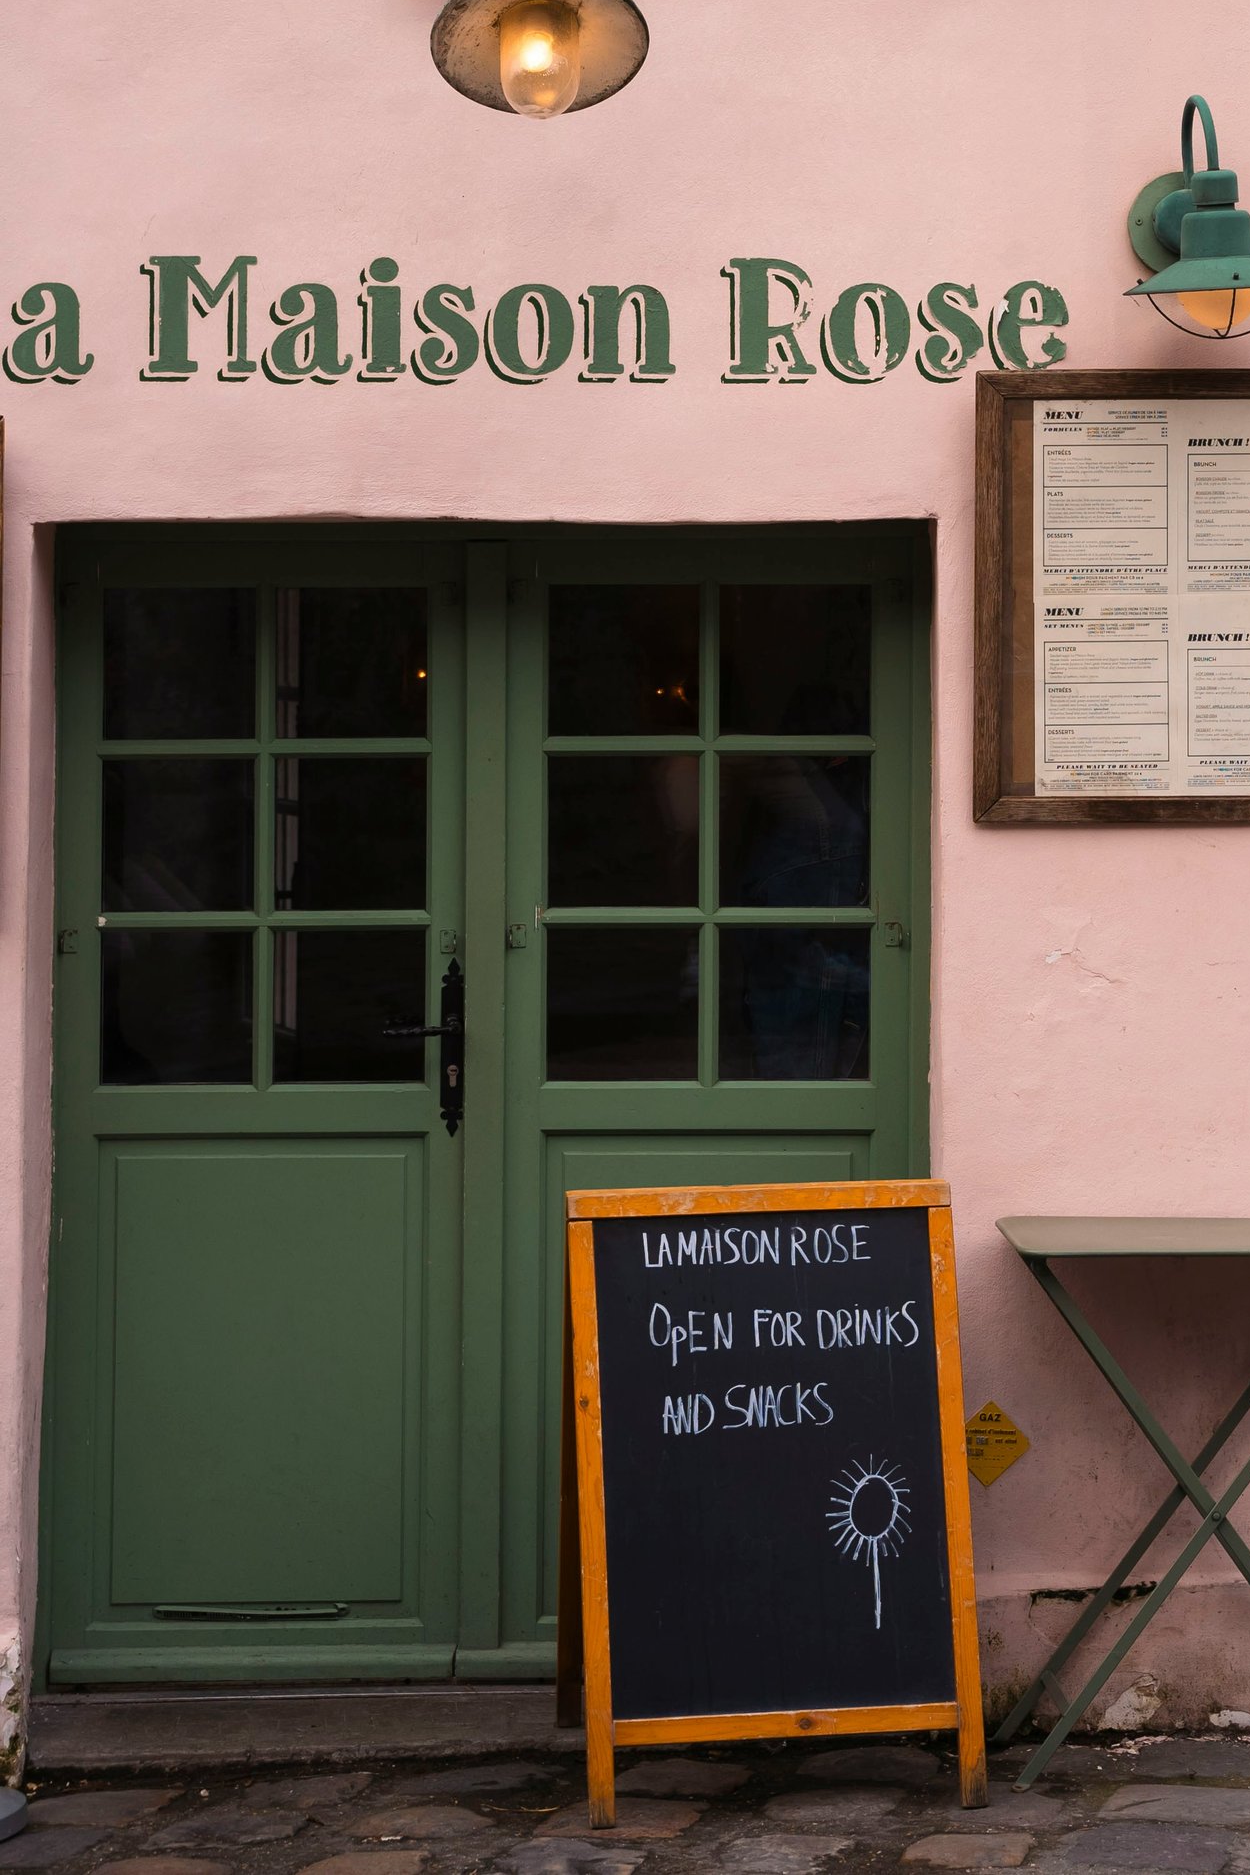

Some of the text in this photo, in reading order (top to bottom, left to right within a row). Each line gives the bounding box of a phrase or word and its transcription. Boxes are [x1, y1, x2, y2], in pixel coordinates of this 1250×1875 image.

[2, 254, 1071, 385] a Maison Rose
[1043, 411, 1083, 420] MENU
[1187, 438, 1244, 447] BRUNCH
[1044, 607, 1084, 616] MENU
[1187, 633, 1244, 642] BRUNCH
[790, 1224, 872, 1267] ROSE
[753, 1308, 806, 1348] FOR
[662, 1382, 835, 1436] AND SNACKS
[979, 1413, 1002, 1422] GAZ
